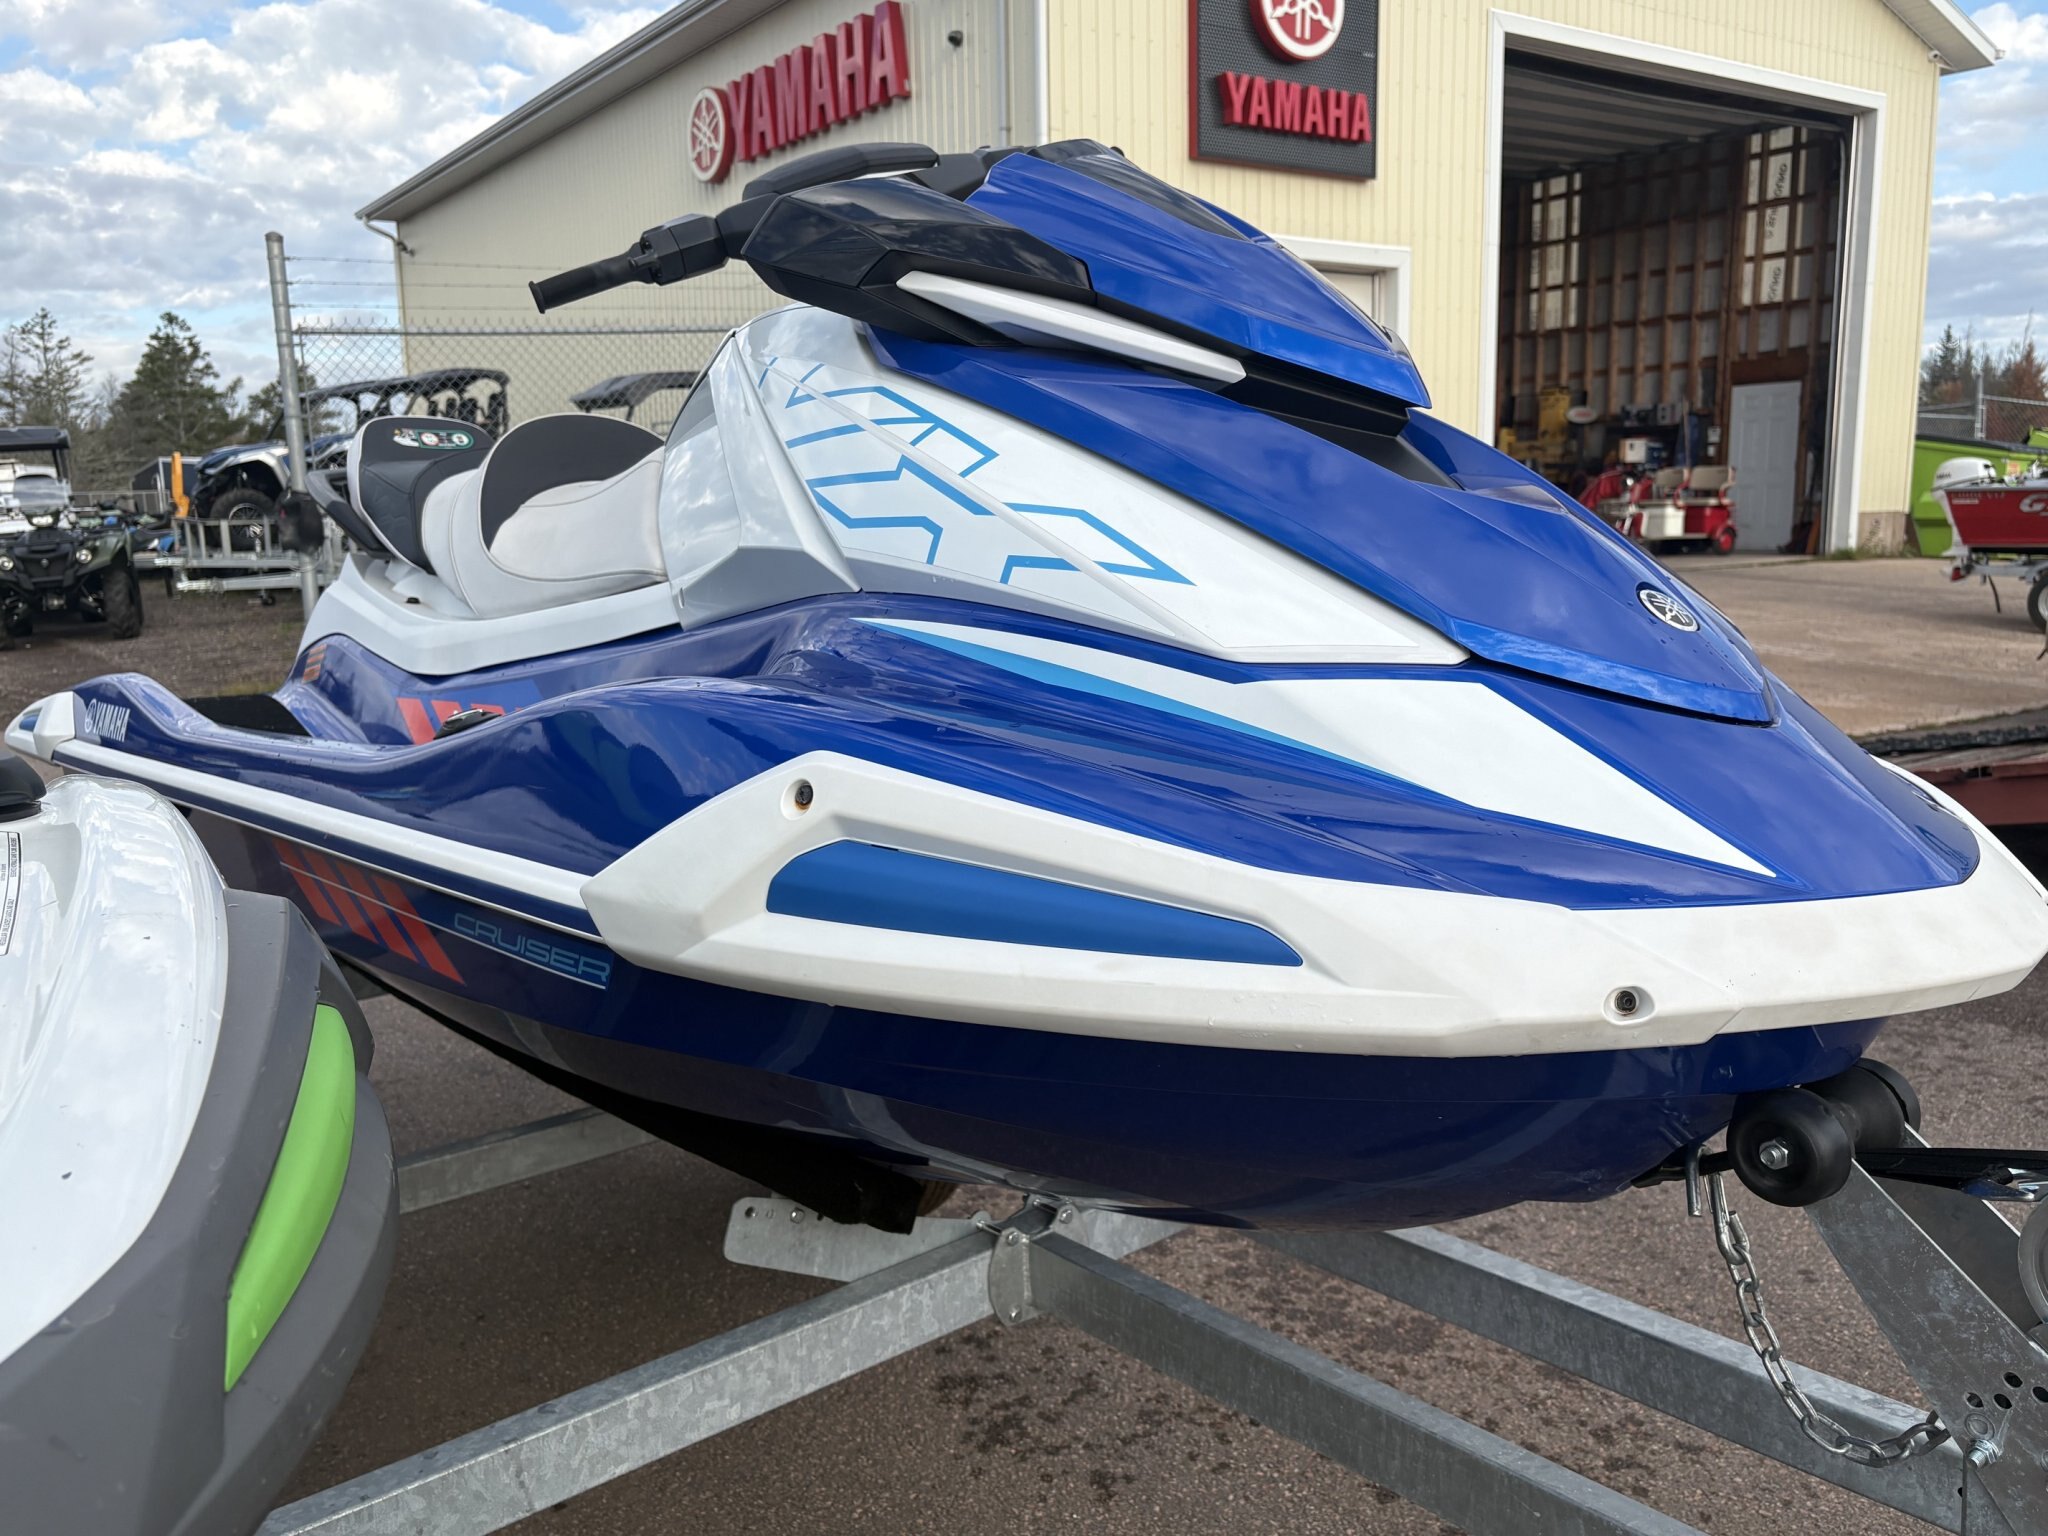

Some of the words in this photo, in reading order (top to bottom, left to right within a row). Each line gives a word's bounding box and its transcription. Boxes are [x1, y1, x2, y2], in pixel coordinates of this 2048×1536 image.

[727, 0, 910, 163] YAMAHA
[1217, 70, 1373, 144] YAMAHA
[93, 701, 131, 742] YAMAHA
[454, 912, 611, 983] CRUISER
